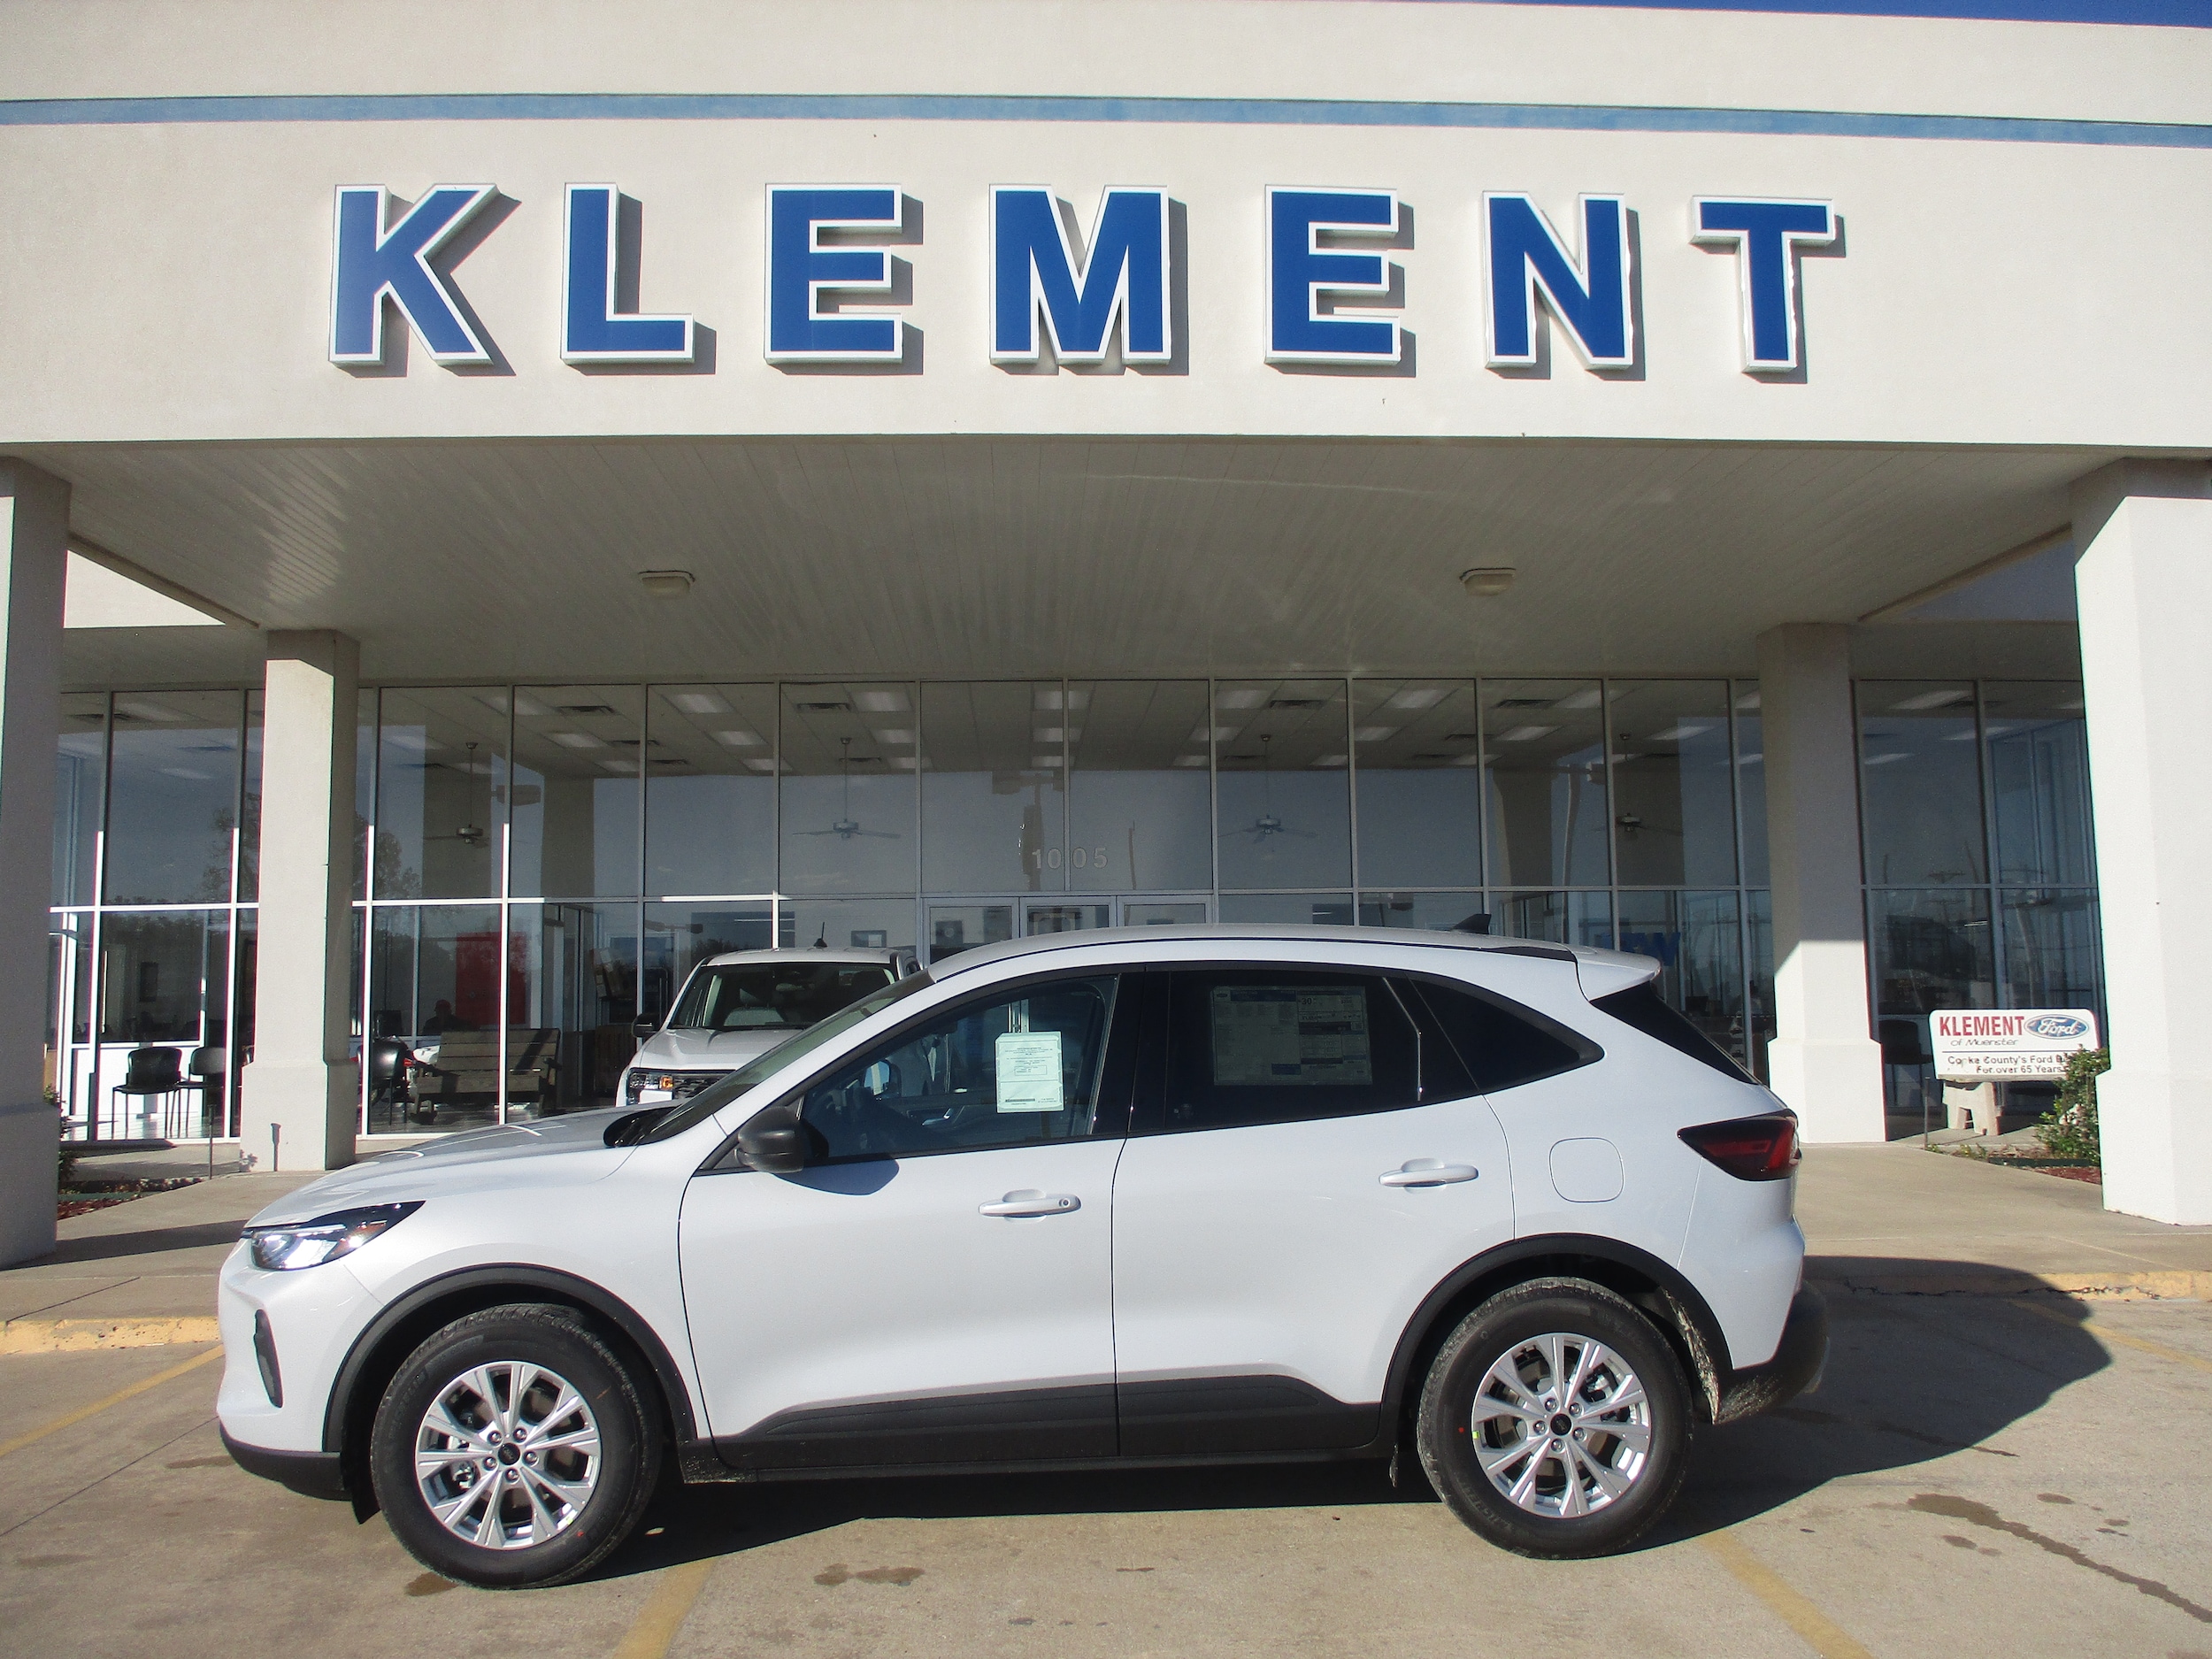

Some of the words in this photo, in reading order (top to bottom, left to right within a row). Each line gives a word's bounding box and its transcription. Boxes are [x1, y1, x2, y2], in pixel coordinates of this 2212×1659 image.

[328, 182, 1837, 373] KLEMENT
[1032, 847, 1108, 869] 1005
[1939, 1016, 2025, 1036] KLEMENT
[2037, 1018, 2077, 1037] Ford
[1950, 1038, 1962, 1047] of
[1965, 1038, 2019, 1047] Muenster
[1947, 1056, 1980, 1064] Coke
[1983, 1056, 2028, 1067] County's
[2030, 1055, 2054, 1064] Ford
[2021, 1064, 2032, 1073] 65
